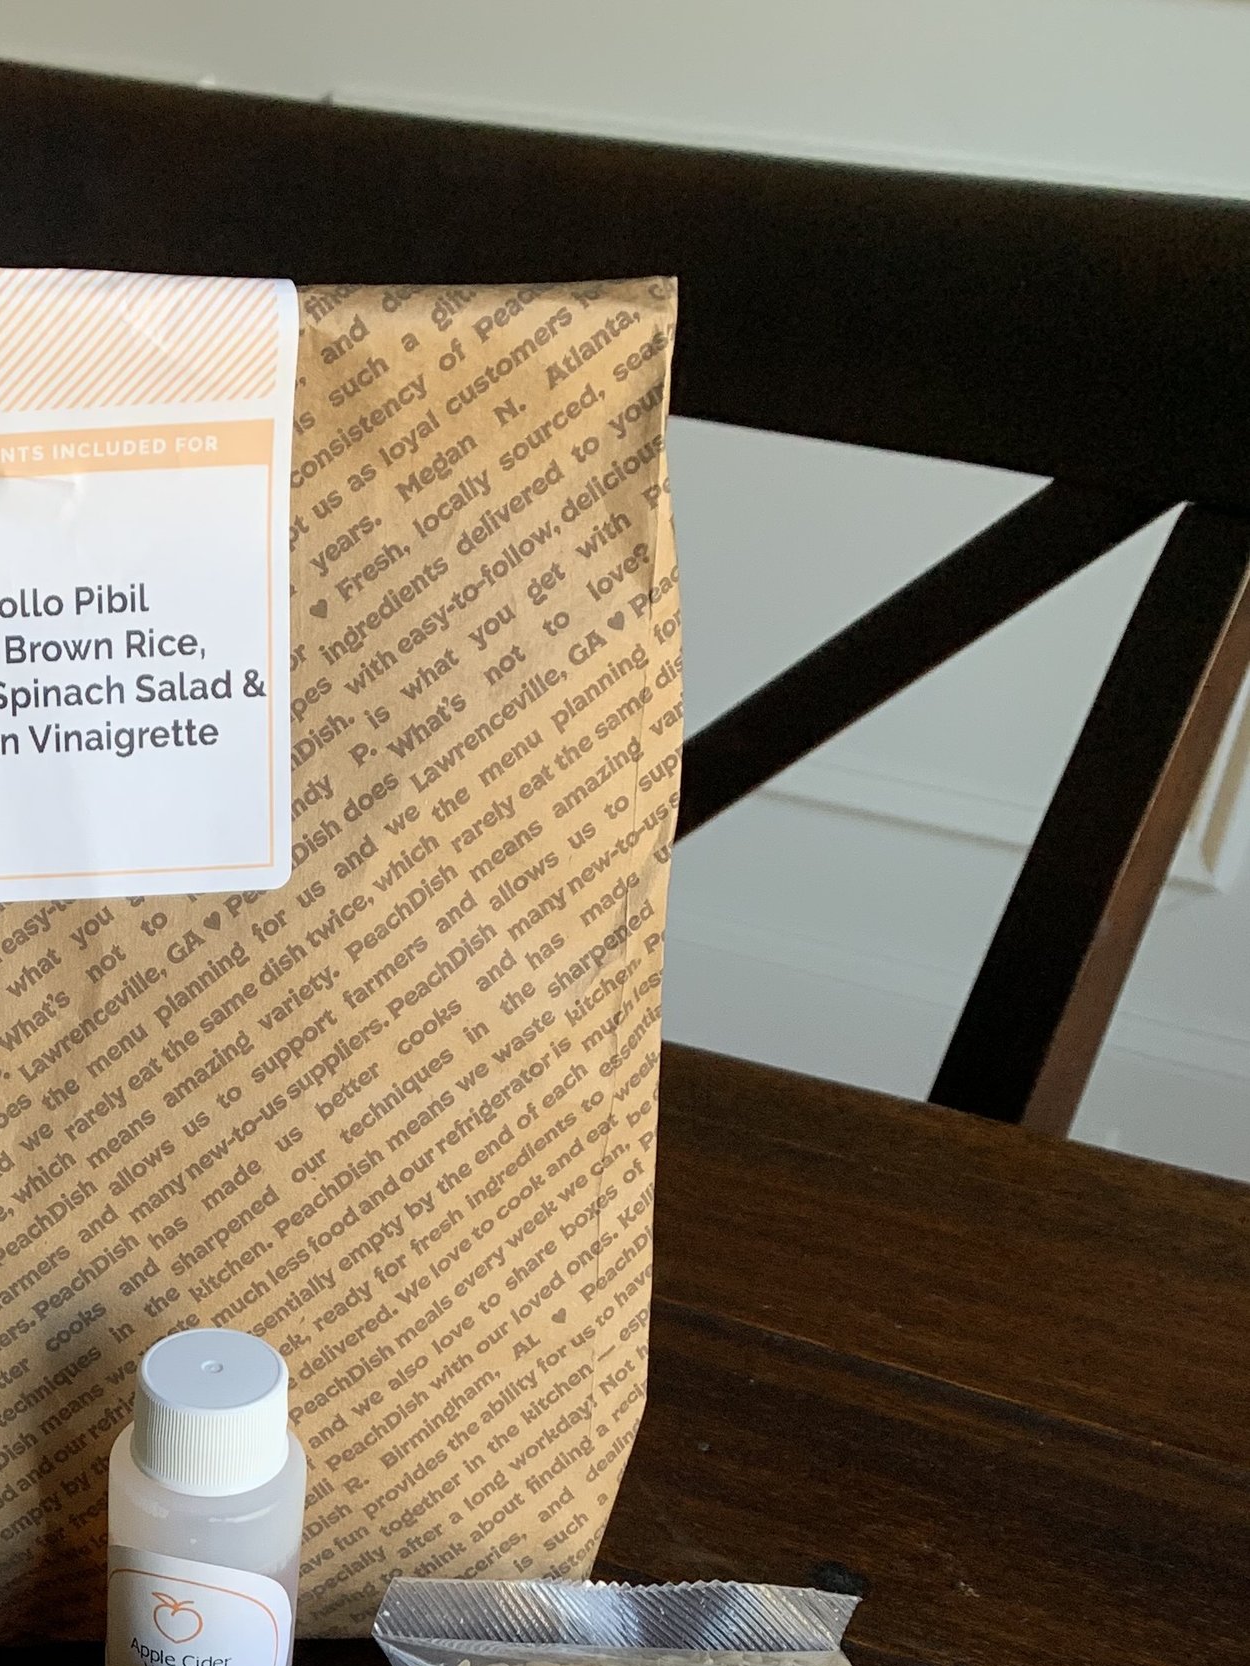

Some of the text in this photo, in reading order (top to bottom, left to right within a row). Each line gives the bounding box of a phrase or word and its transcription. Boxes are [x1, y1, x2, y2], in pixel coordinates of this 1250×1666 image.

[53, 439, 166, 459] INCLUDED
[176, 436, 219, 453] FOR
[310, 311, 641, 578] years. Megan N. Atlanta,
[311, 306, 572, 520] us as loyal customers
[75, 583, 149, 615] Pibil
[318, 379, 665, 667] ingredients delivered to your
[343, 433, 663, 696] with easy-to-follow, delicious
[5, 635, 112, 664] Brown
[126, 628, 205, 659] Rice,
[28, 719, 219, 758] Vinaigrette
[136, 670, 232, 702] Salad
[243, 669, 266, 697] &
[385, 541, 651, 759] What's not to love?
[17, 929, 206, 1084] Lawrenceville, GA
[41, 805, 421, 1112] the menu planning for us and we
[63, 835, 440, 1142] rarely eat the same dish twice, which
[85, 865, 459, 1170] means amazing variety. PeachDish
[107, 889, 478, 1197] allows us to support farmers and
[147, 949, 518, 1251] has made us better cooks and
[287, 1143, 631, 1427] PeachDish meals every week we can,
[307, 1293, 501, 1450] and we also love to
[472, 1434, 593, 1544] about finding
[486, 1363, 595, 1454] the kitchen
[131, 1637, 176, 1666] Apple
